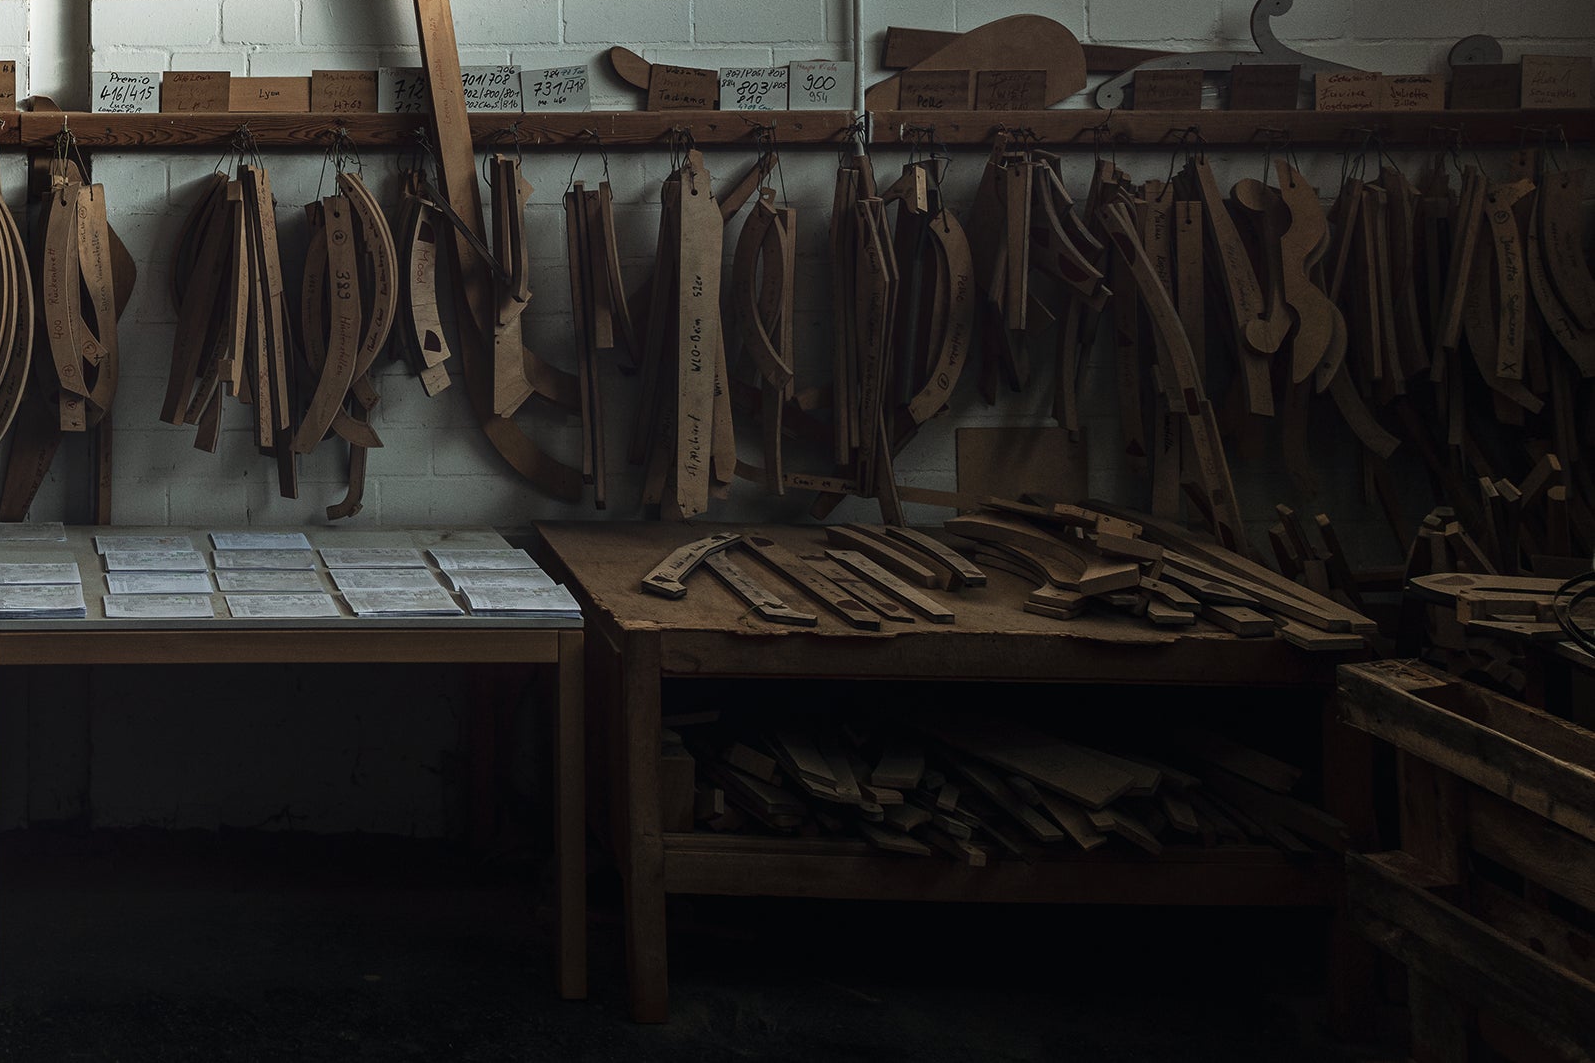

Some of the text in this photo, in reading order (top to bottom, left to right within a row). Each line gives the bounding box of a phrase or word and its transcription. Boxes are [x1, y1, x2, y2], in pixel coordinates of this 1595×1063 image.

[109, 72, 151, 84] Premio
[802, 74, 837, 91] 900
[100, 84, 155, 103] 416/415
[415, 248, 431, 285] Mood
